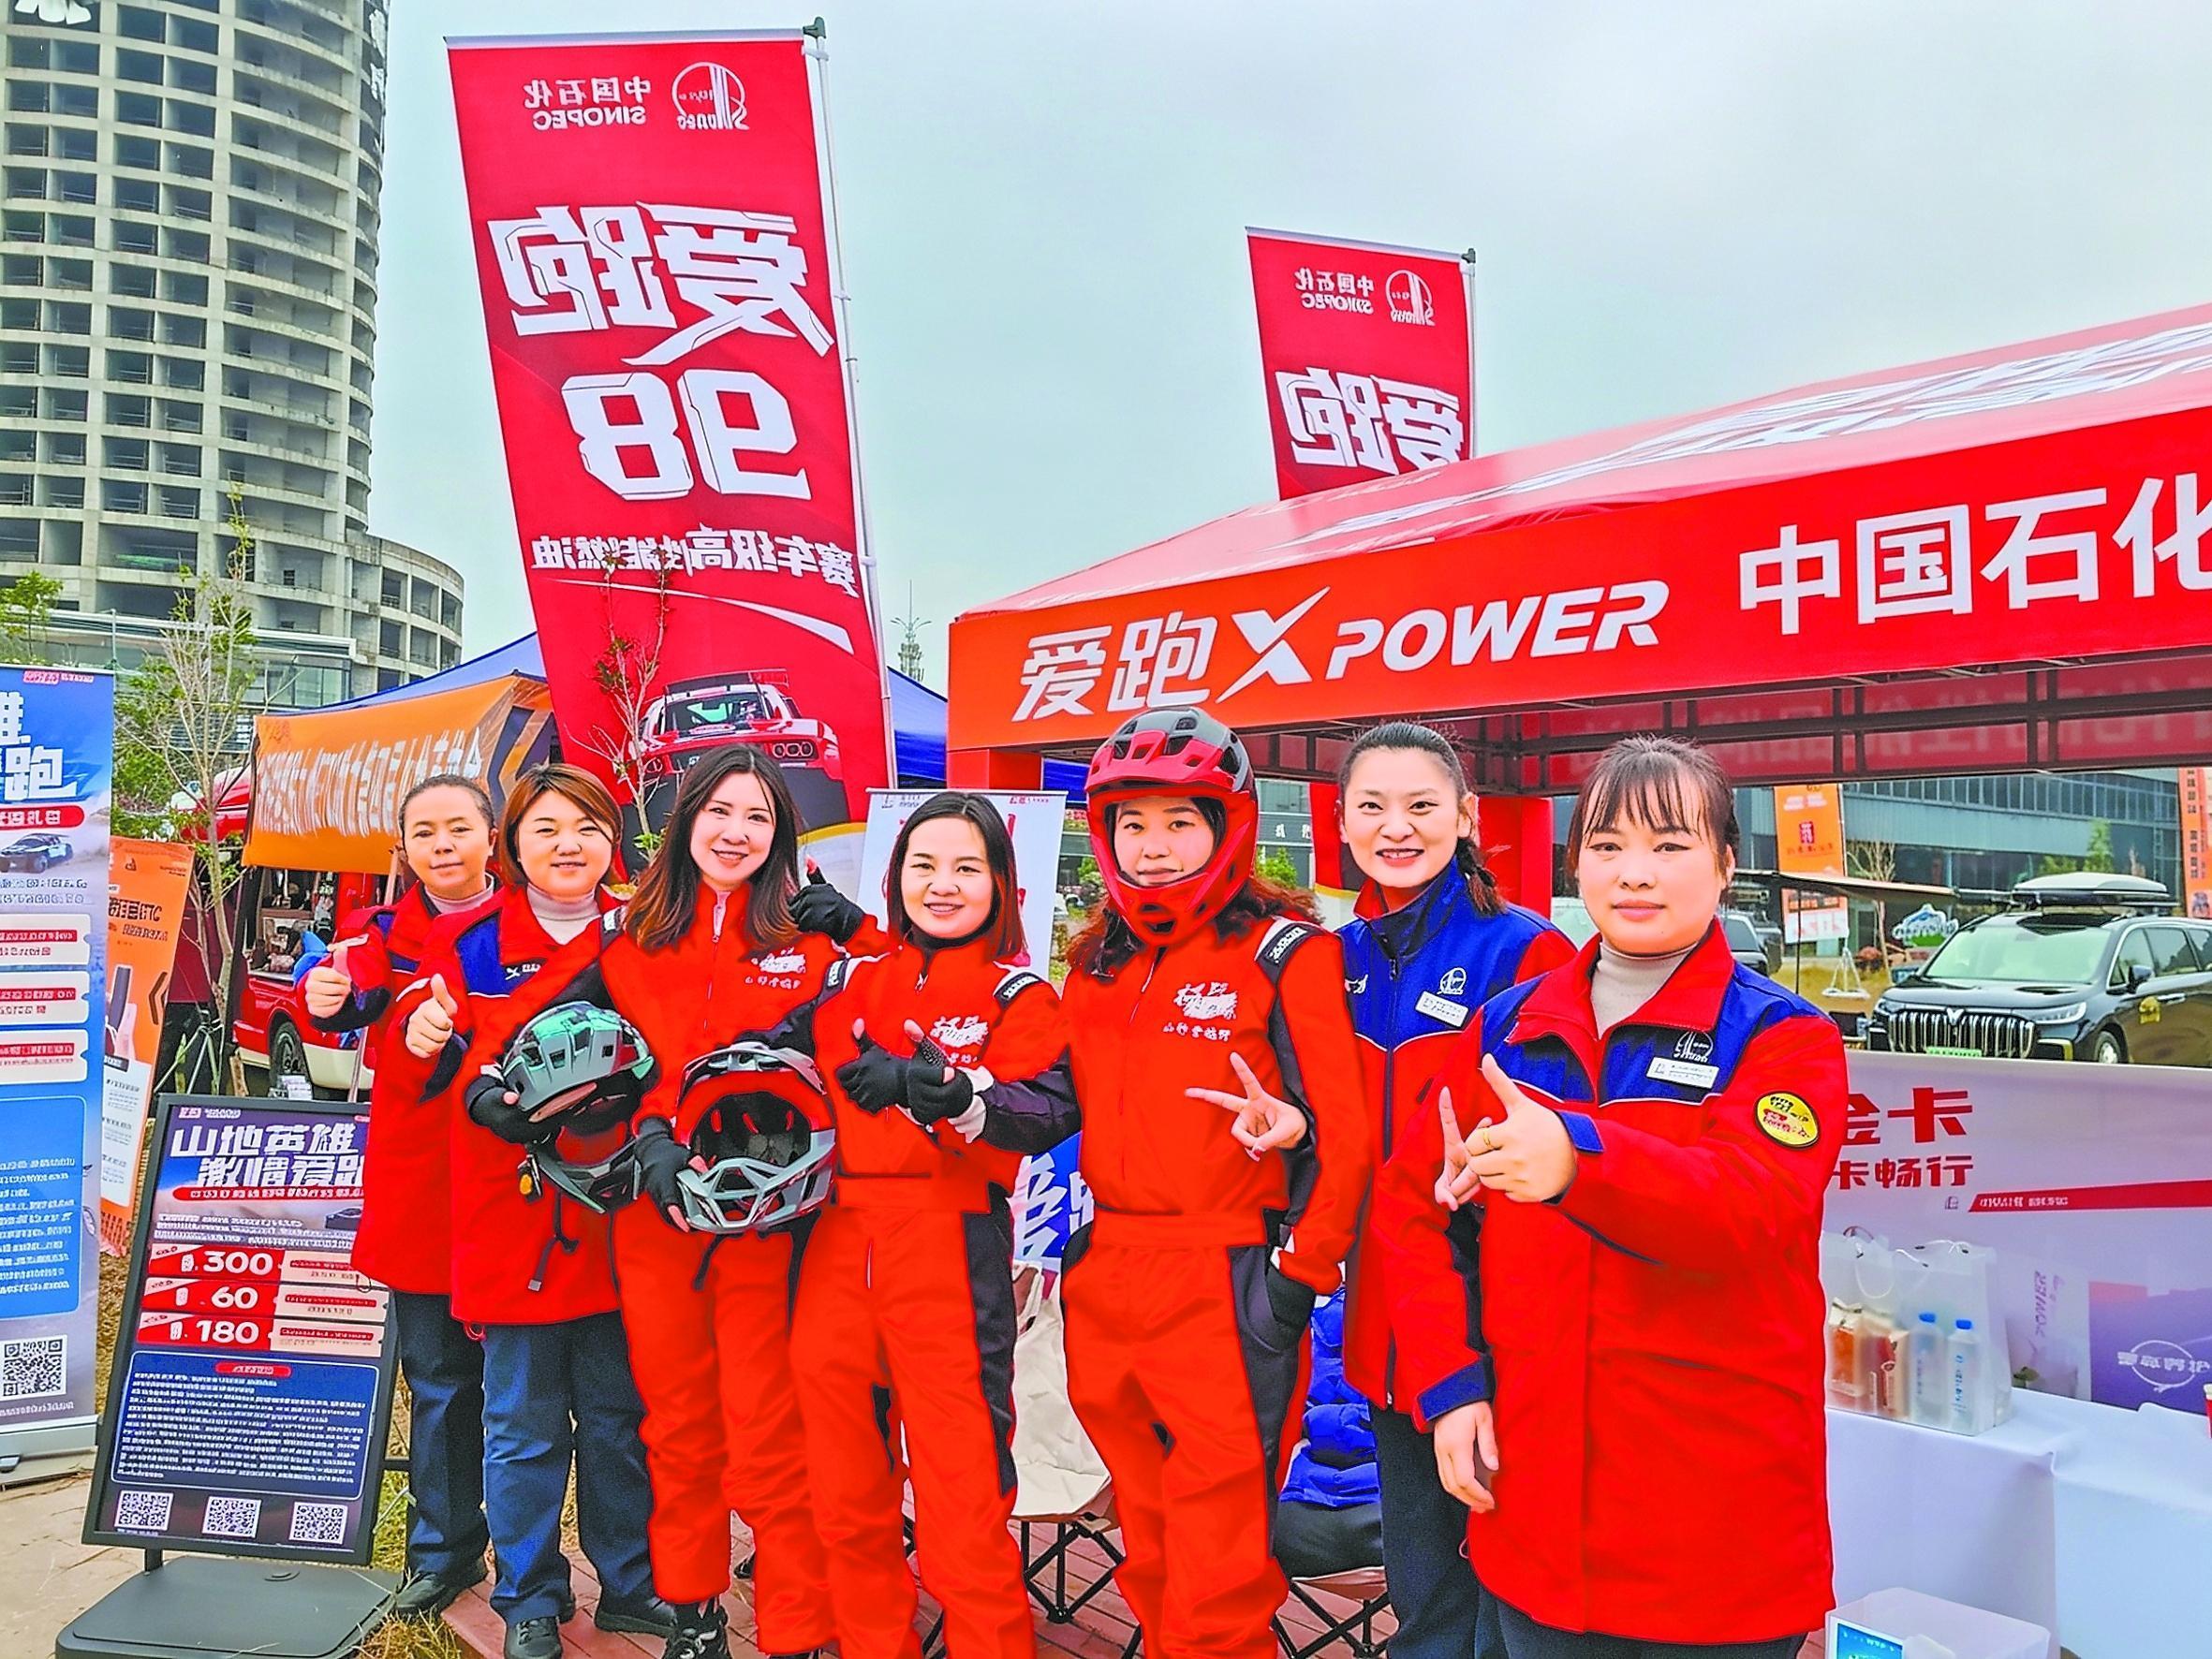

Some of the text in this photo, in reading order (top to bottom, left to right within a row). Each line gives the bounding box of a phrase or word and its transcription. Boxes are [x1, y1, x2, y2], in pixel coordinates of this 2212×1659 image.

[1011, 609, 1217, 722] 爱跑
[1739, 473, 2212, 636] 中国石化
[170, 1123, 360, 1157] 山地英雄
[202, 1250, 273, 1276] 300
[211, 1285, 258, 1310] 60
[196, 1320, 259, 1344] 180
